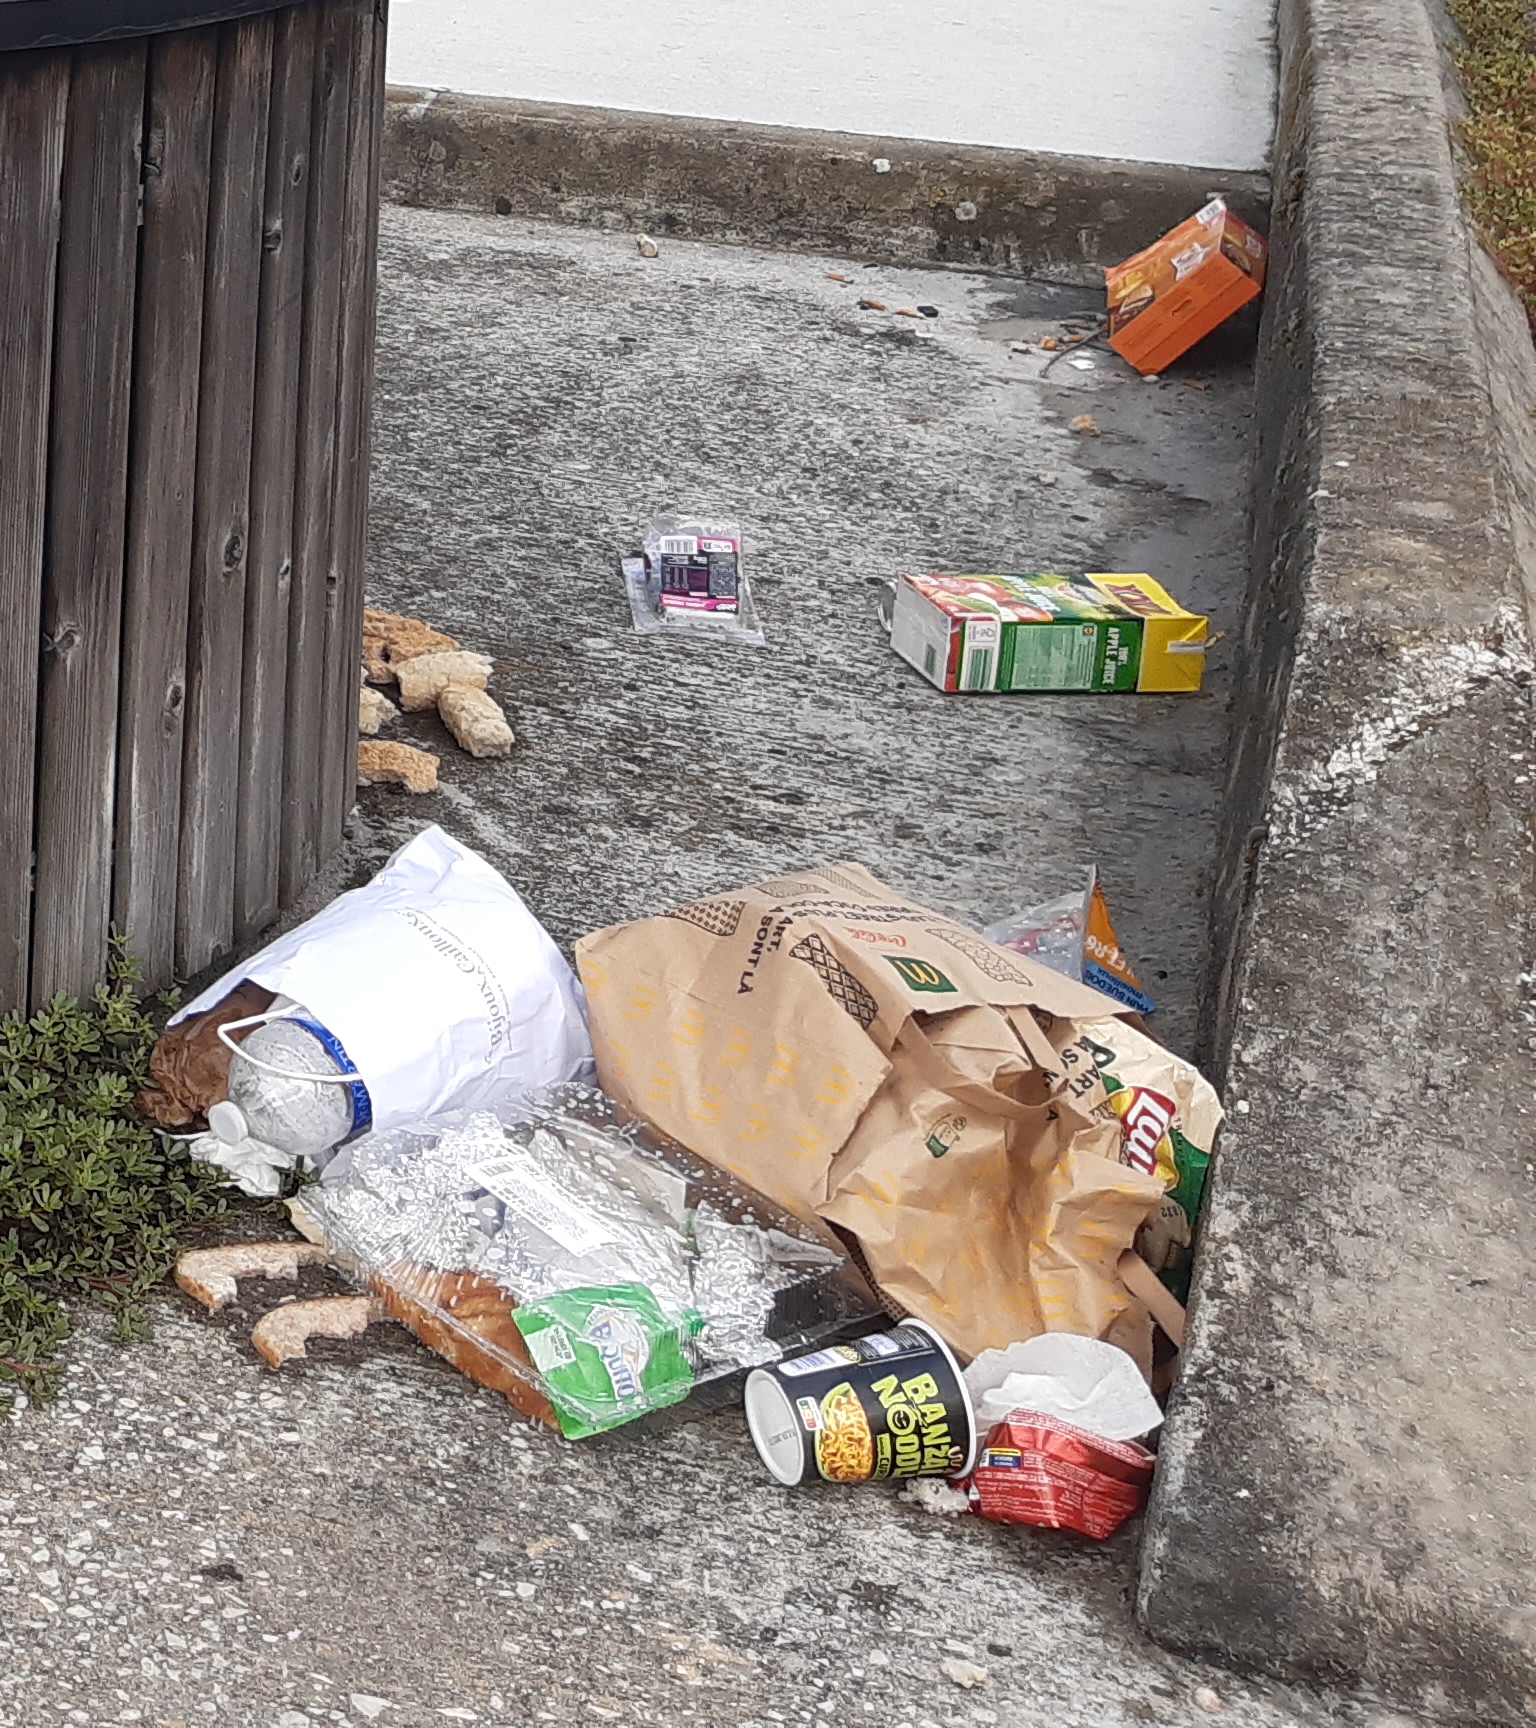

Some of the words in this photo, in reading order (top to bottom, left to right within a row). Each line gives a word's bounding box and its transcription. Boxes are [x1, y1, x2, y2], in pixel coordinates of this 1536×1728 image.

[1106, 627, 1121, 657] APPLE
[1102, 658, 1116, 685] JUICE
[747, 915, 775, 968] SONT
[871, 1374, 919, 1479] NOODL
[901, 1372, 952, 1475] BANZAI
